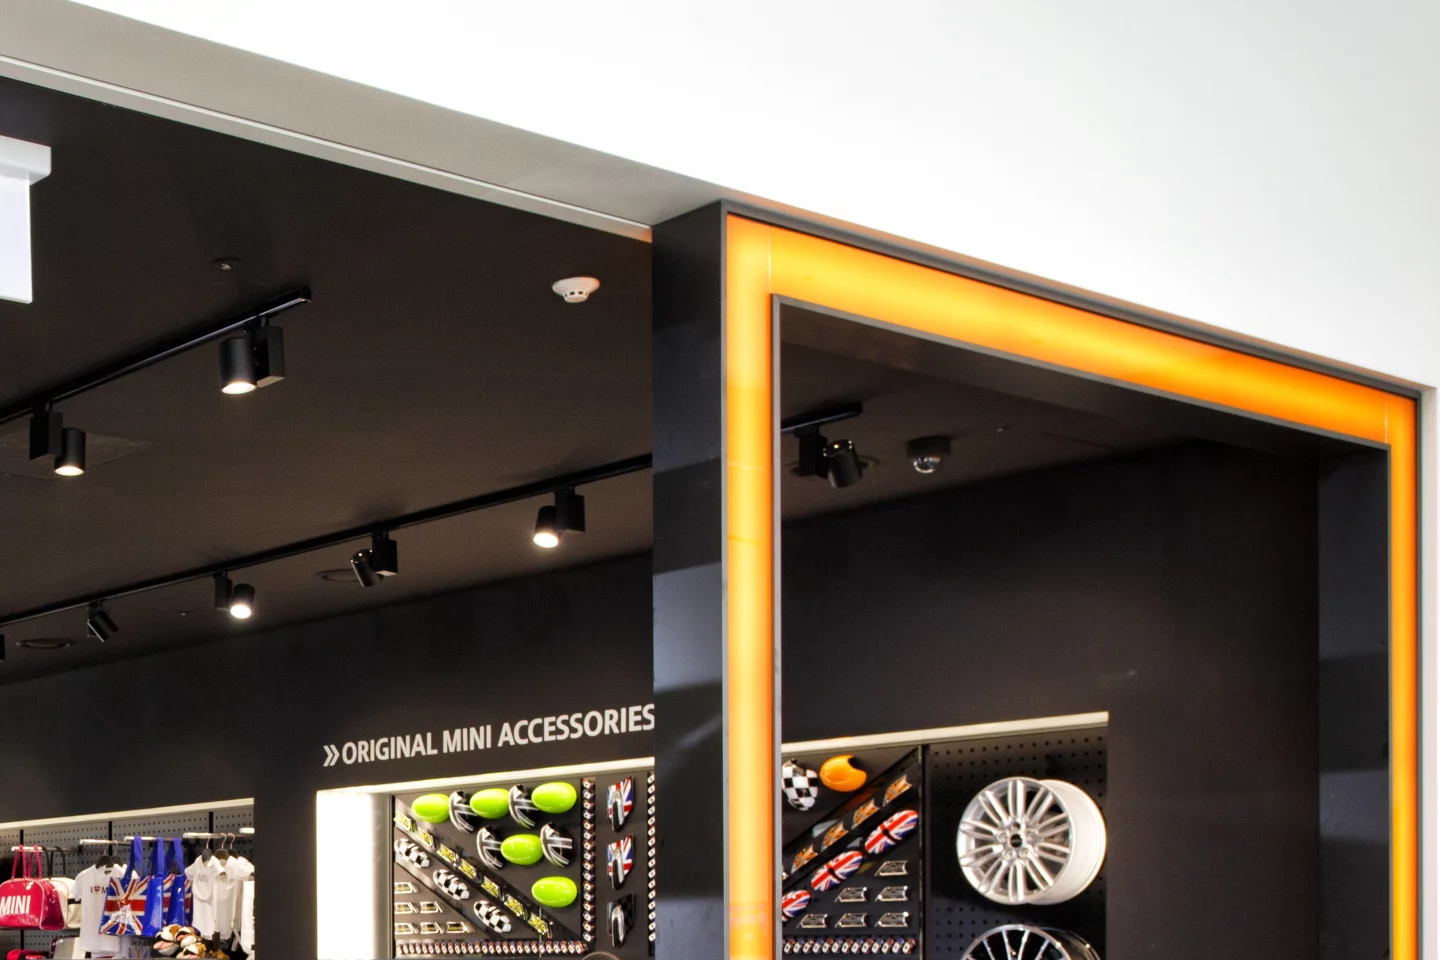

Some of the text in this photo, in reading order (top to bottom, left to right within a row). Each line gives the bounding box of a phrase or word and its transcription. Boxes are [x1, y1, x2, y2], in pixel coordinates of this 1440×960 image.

[341, 703, 655, 765] ORIGINAL MINI ACCESSORIES
